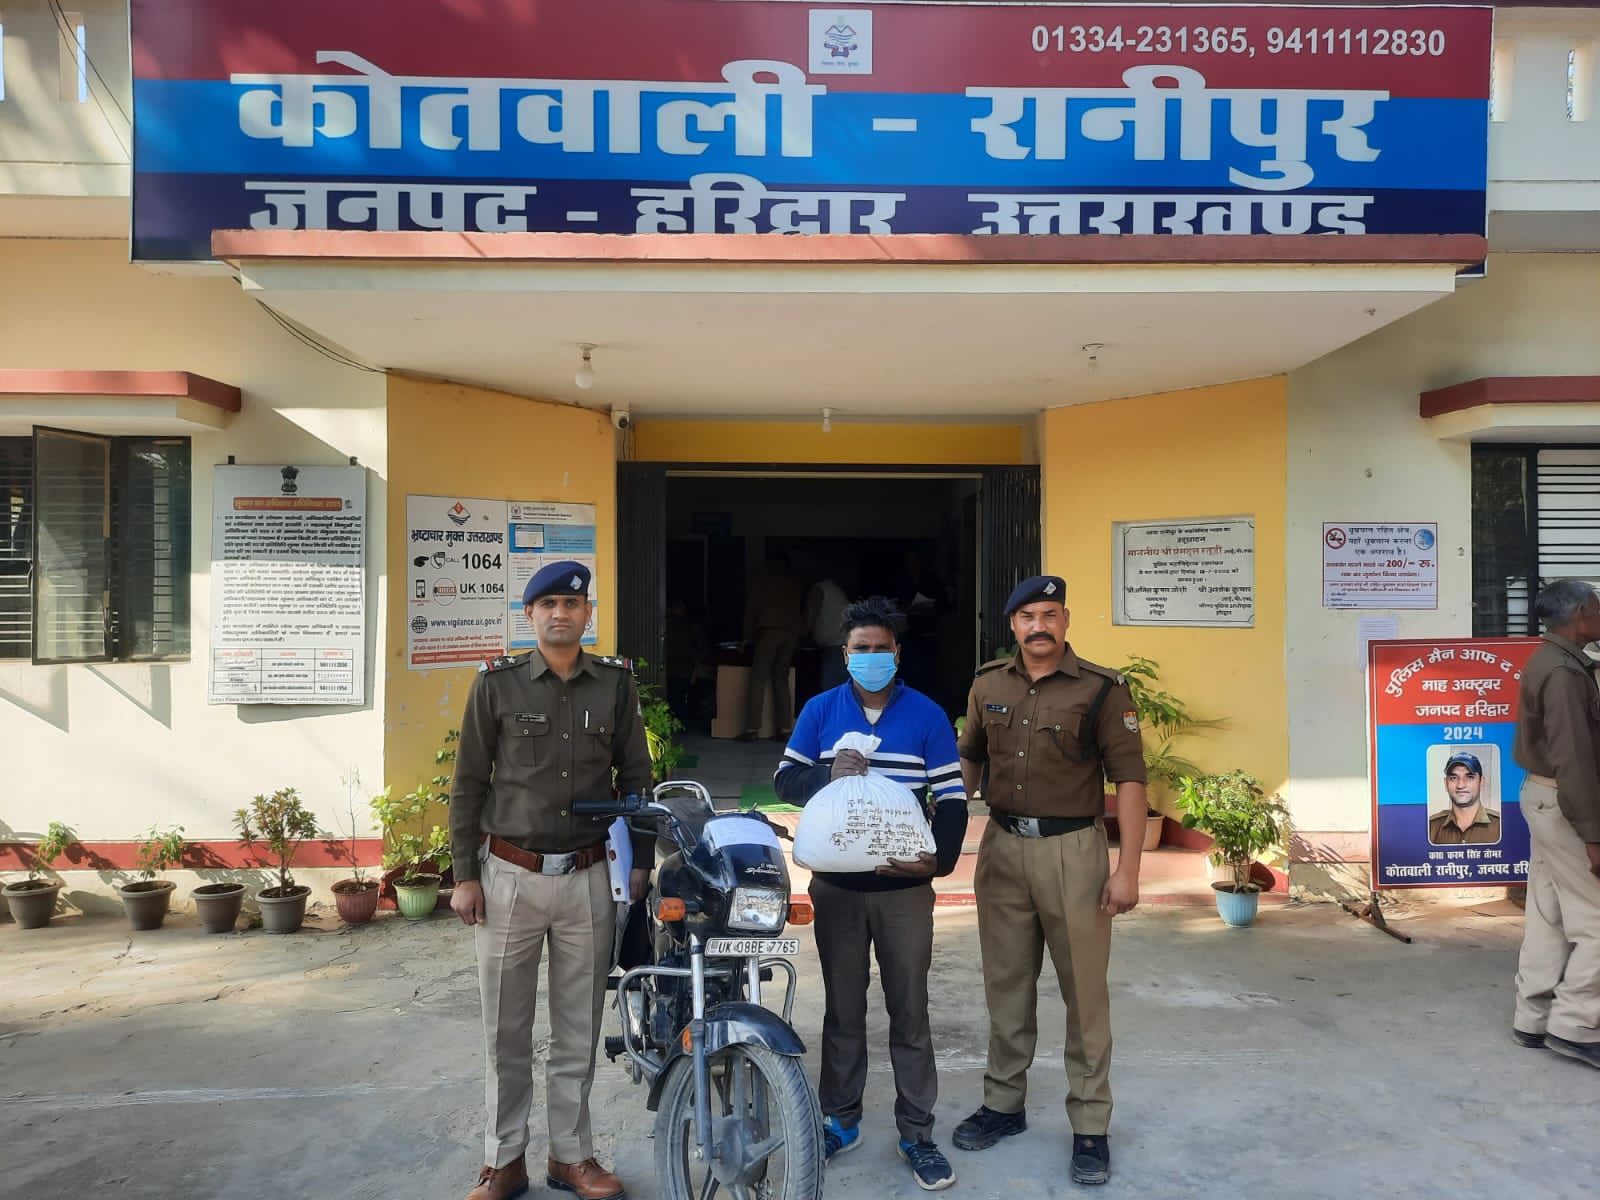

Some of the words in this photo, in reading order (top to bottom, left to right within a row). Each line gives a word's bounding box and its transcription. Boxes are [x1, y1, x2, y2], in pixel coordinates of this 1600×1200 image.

[1031, 25, 1256, 58] 01334-231365,
[1266, 27, 1446, 56] 9411112830
[230, 51, 827, 158] कोतवाली
[965, 65, 1390, 191] रानीपुर
[244, 181, 537, 232] जनपद
[411, 530, 444, 542] भ्रष्टाचार
[445, 531, 465, 547] मुक्त
[466, 532, 504, 544] उत्तराखण्ड
[462, 553, 502, 569] 1064
[460, 583, 476, 594] UK
[480, 583, 504, 593] 1064
[1384, 658, 1425, 697] पुलिस
[1427, 647, 1455, 664] मैन
[1499, 658, 1514, 673] द
[1421, 679, 1448, 692] माह
[1452, 678, 1502, 696] अक्टूबर
[1415, 704, 1461, 716] जनपद
[1464, 699, 1510, 717] हरिद्वार
[1443, 726, 1483, 741] 2024
[1467, 848, 1481, 860] सिंह
[1385, 862, 1432, 877] कोतवाली
[1435, 862, 1473, 880] रानीपुर,
[1477, 863, 1510, 875] जनपद
[718, 941, 733, 954] UK
[770, 941, 797, 953] 7765
